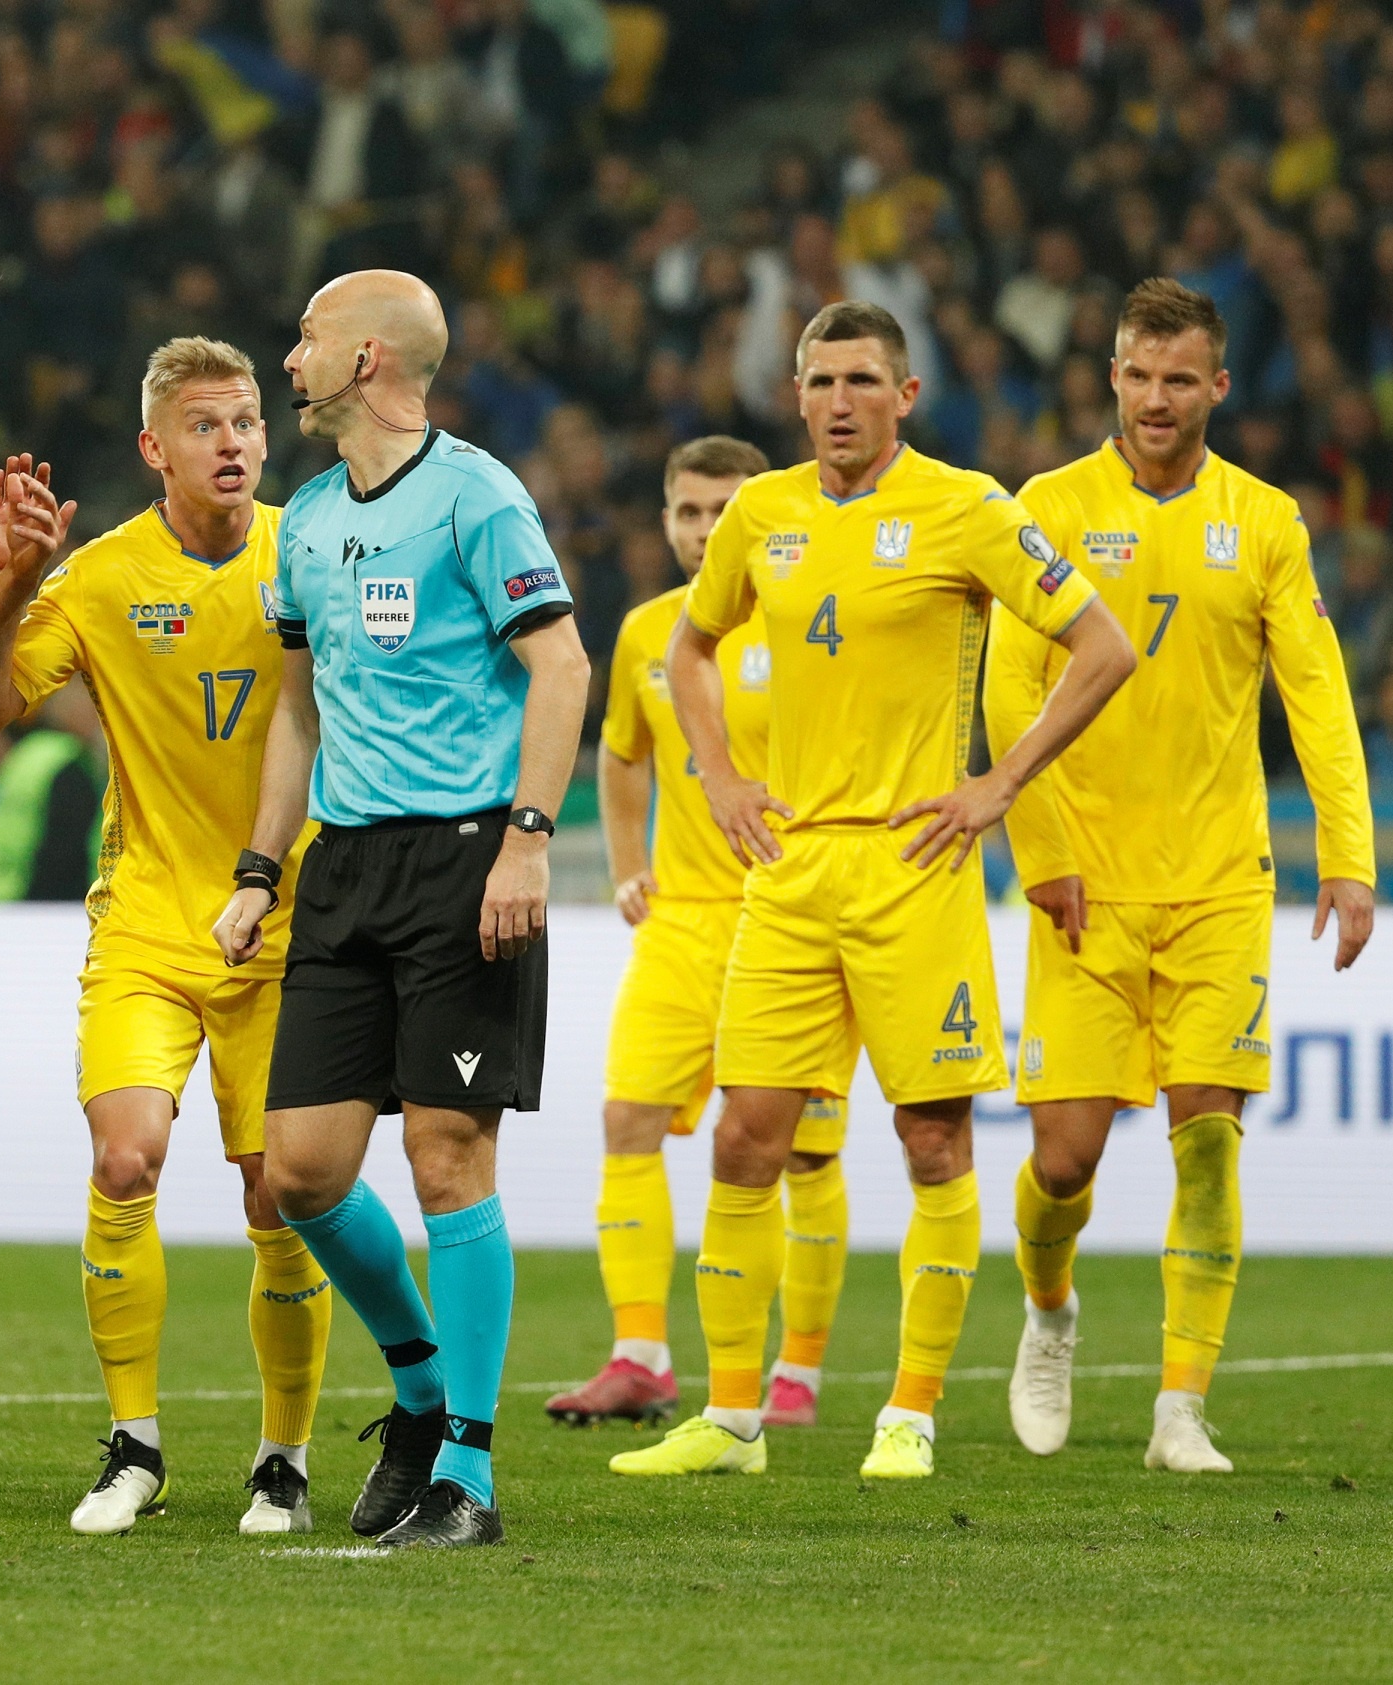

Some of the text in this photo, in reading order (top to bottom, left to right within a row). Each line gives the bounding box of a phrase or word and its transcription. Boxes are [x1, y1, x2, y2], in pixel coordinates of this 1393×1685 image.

[366, 584, 408, 600] FIFA
[366, 613, 410, 622] REFEREE
[379, 637, 399, 646] 2019
[806, 594, 843, 656] 4
[1146, 594, 1178, 656] 7
[198, 669, 257, 741] 17
[942, 981, 977, 1043] 4
[1251, 975, 1268, 1035] 7
